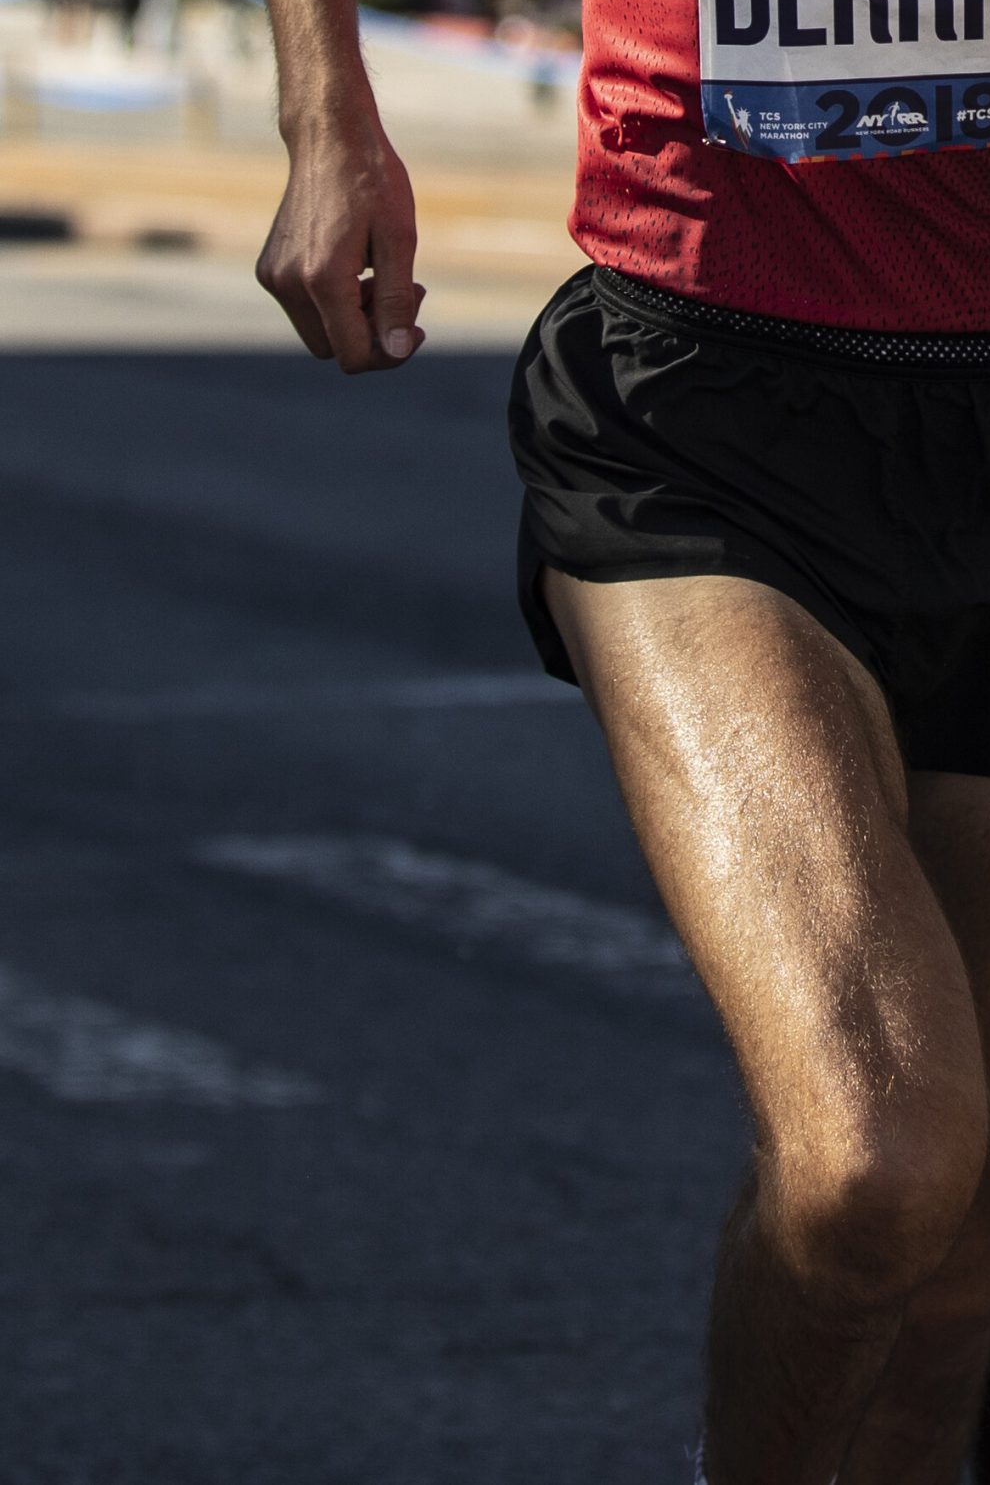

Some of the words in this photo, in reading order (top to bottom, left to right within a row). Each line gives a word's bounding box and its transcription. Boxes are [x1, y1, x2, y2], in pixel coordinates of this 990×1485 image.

[759, 112, 781, 121] TCS
[807, 121, 829, 130] CITY
[760, 132, 810, 140] MARATHON
